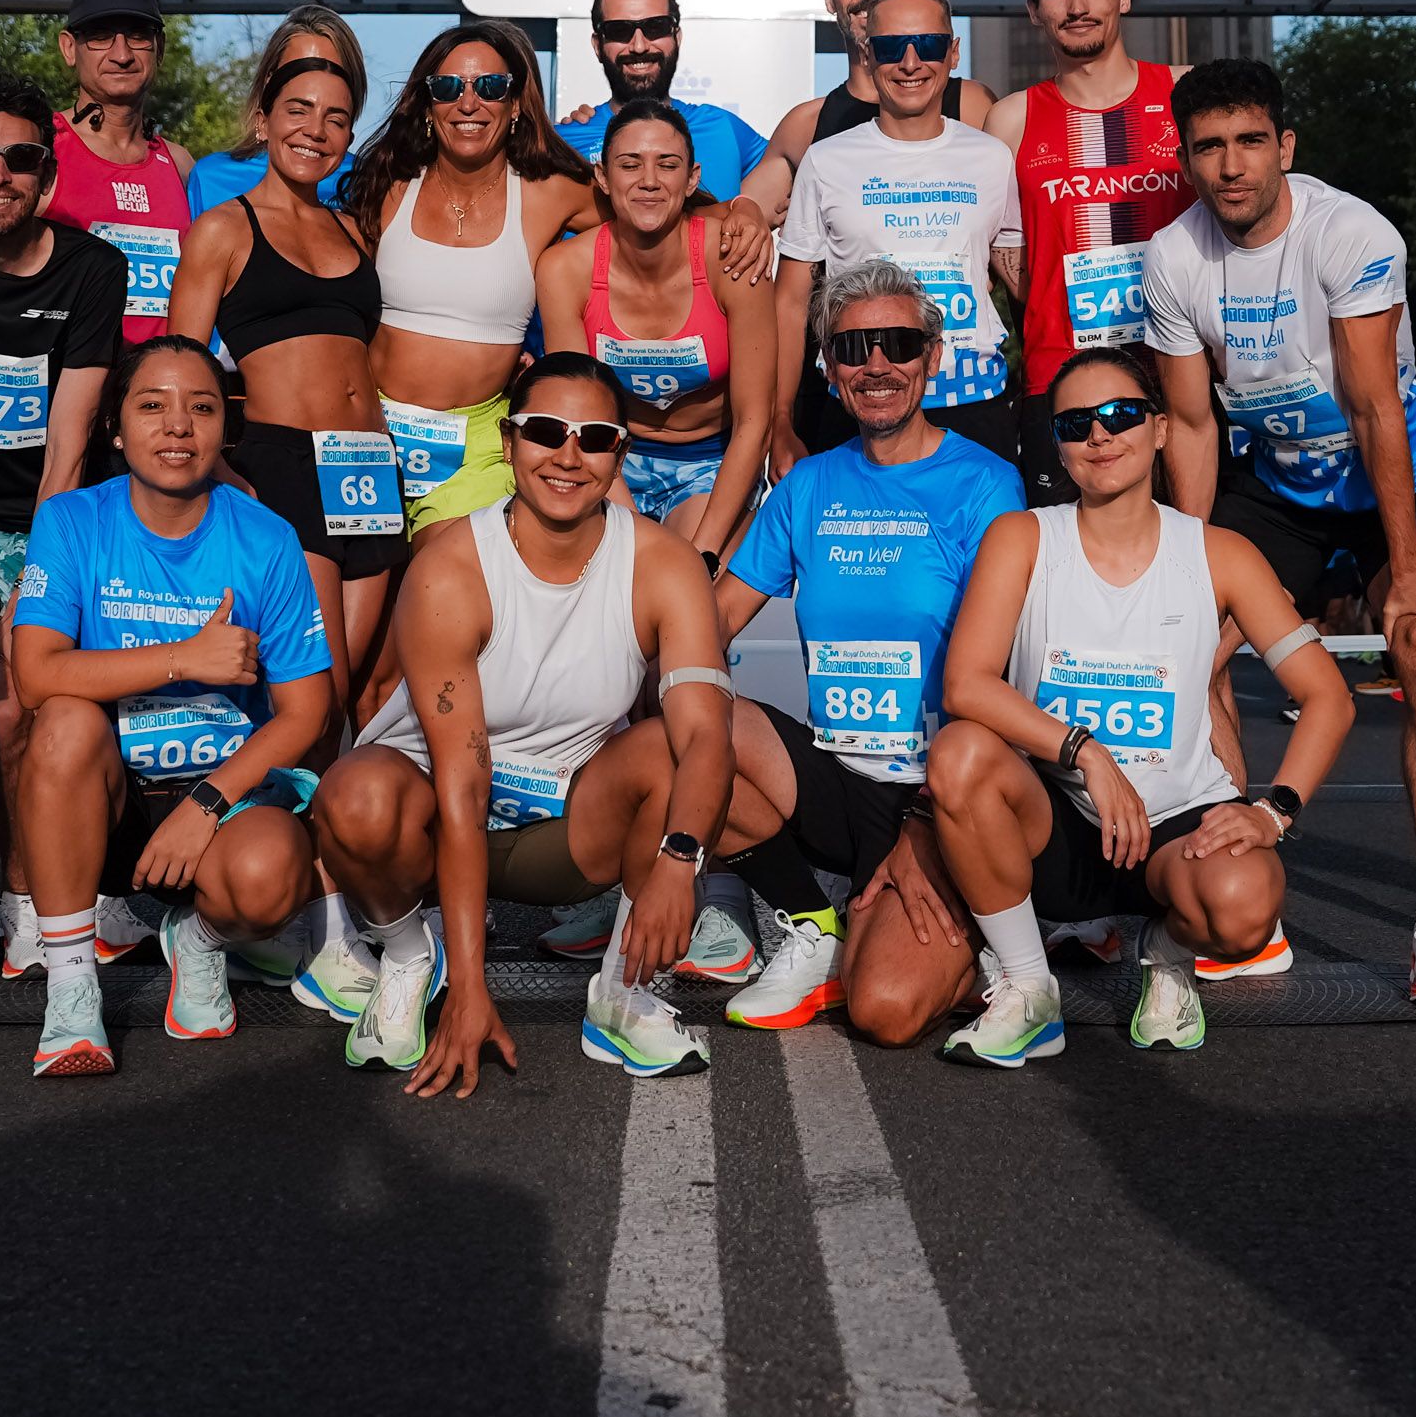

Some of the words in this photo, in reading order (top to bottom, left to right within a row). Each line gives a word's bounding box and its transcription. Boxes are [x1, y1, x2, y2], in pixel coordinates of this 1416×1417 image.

[895, 181, 917, 189] Royal
[947, 181, 976, 189] Airlines
[1041, 169, 1178, 203] TARANCÓN
[116, 191, 149, 203] BEACH
[863, 192, 911, 205] NORTE
[922, 191, 940, 202] VS
[952, 191, 977, 204] SUR
[124, 202, 150, 212] CLUB
[884, 214, 919, 227] Run
[926, 211, 960, 226] Well
[1116, 252, 1137, 260] Dutch
[1074, 266, 1111, 281] NORTE
[1231, 296, 1253, 305] Royal
[1225, 333, 1256, 348] Run
[605, 353, 642, 364] NORTE
[674, 354, 698, 364] SUR
[12, 365, 38, 373] Airlines
[15, 374, 39, 385] SUR
[631, 374, 679, 396] 59
[1264, 410, 1305, 435] 67
[322, 451, 353, 462] NORTE
[341, 475, 377, 505] 68
[817, 521, 862, 535] NORTE
[871, 522, 888, 535] VS
[896, 522, 929, 536] SUR
[829, 546, 863, 562] Run
[869, 546, 902, 562] Well
[839, 566, 886, 575] 21.06.2026
[101, 586, 132, 597] KLM
[139, 590, 162, 601] Royal
[101, 601, 155, 621] NORTE
[166, 607, 188, 625] VS
[817, 661, 852, 673] NORTE
[885, 662, 909, 675] SUR
[1082, 661, 1104, 670] Royal
[1107, 662, 1131, 670] Dutch
[1050, 667, 1096, 684] NORTE
[826, 687, 901, 722] 884
[129, 713, 175, 730] NORTE
[1043, 697, 1164, 738] 4563
[129, 734, 244, 769] 5064
[505, 763, 529, 773] Dutch
[501, 773, 521, 787] VS
[529, 779, 558, 795] SUR
